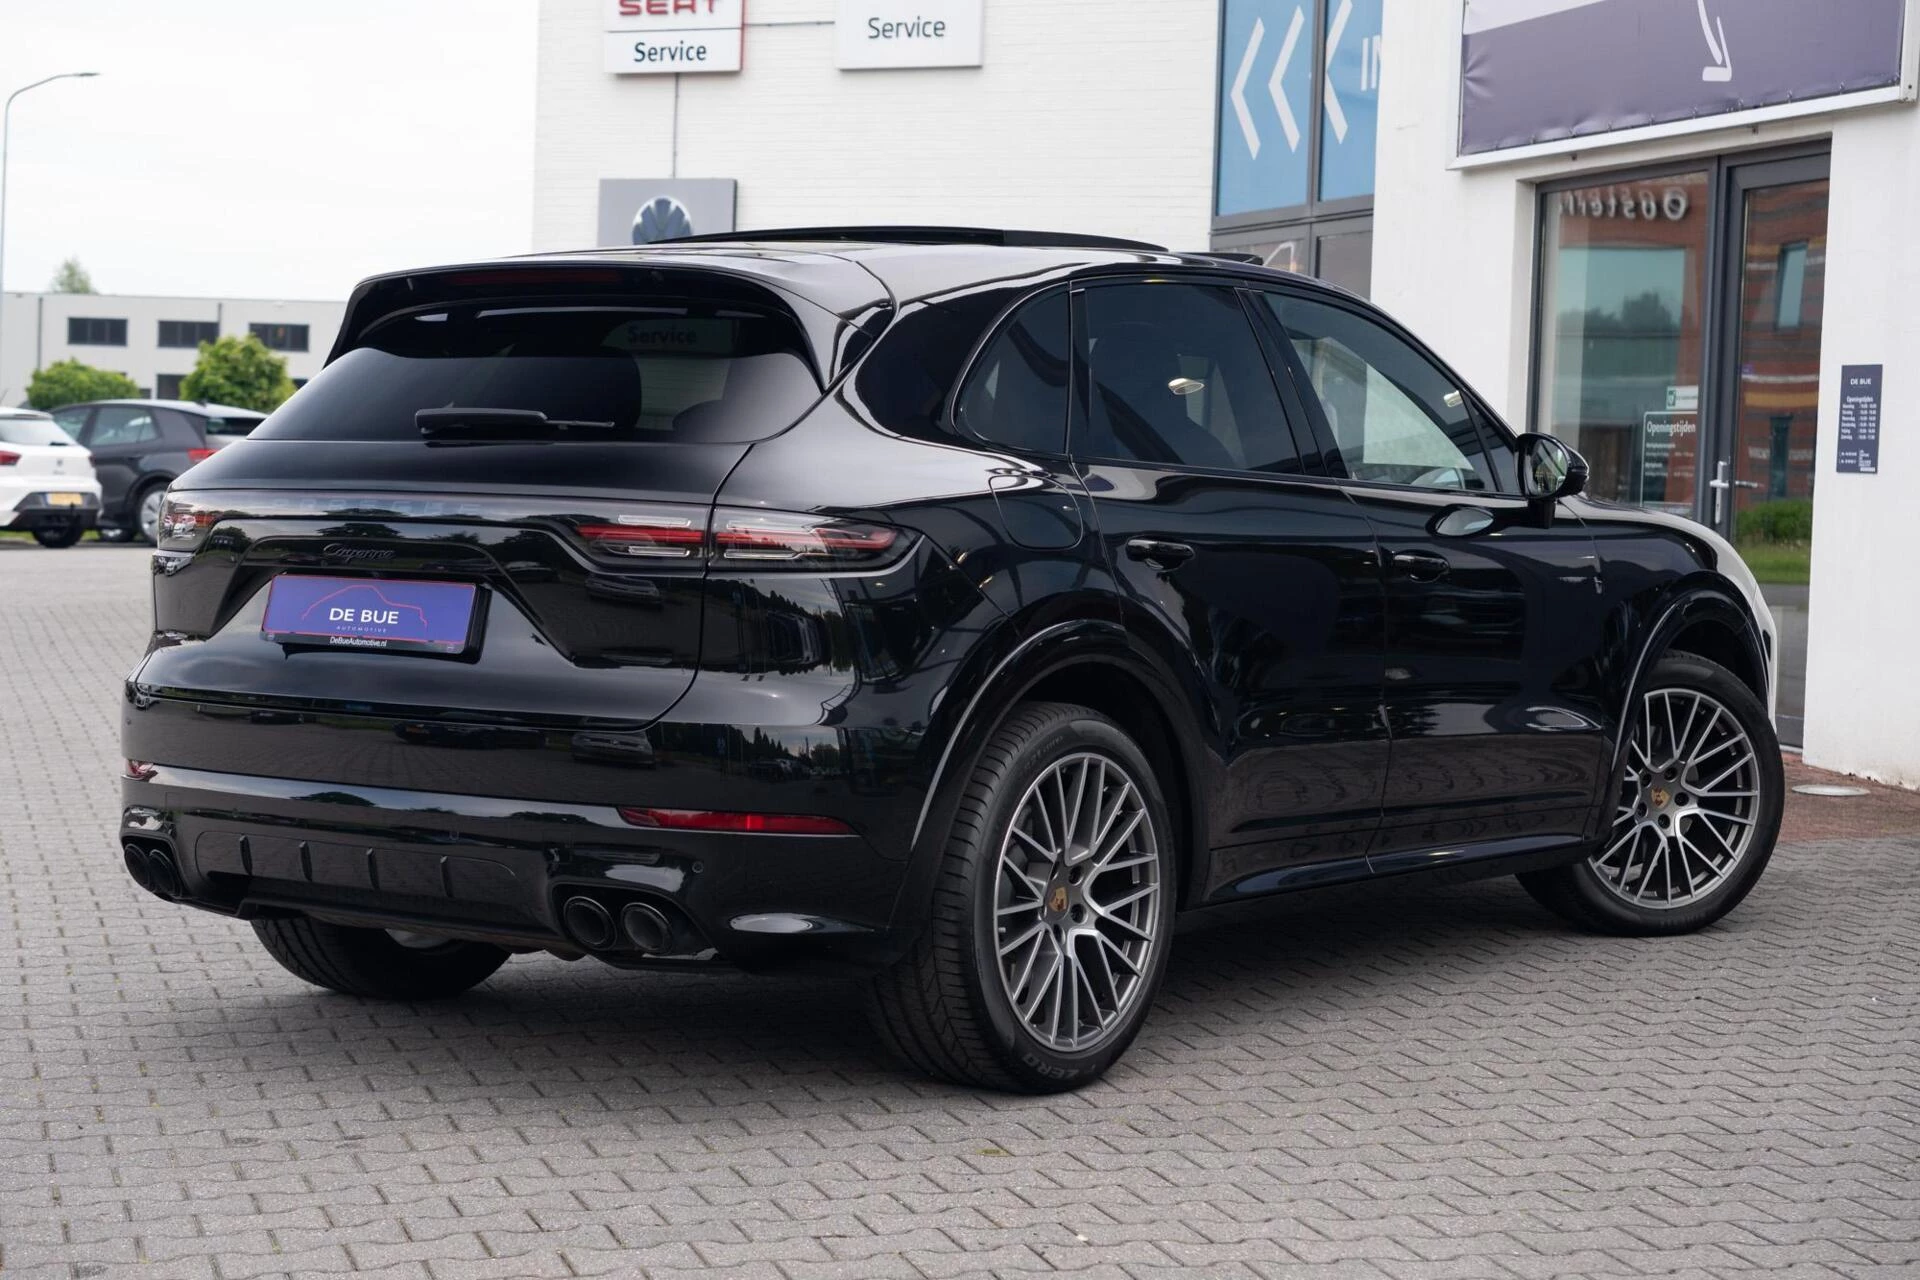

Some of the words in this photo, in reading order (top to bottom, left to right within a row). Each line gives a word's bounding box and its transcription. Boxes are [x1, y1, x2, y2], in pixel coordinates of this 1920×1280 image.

[867, 16, 946, 39] Service
[633, 40, 707, 62] Service
[1646, 420, 1696, 436] Openingstijden
[329, 607, 355, 622] DE
[360, 609, 399, 624] BUE
[336, 625, 387, 633] AUTOMOTIVE
[329, 636, 387, 647] DeBueAutomotive.nl
